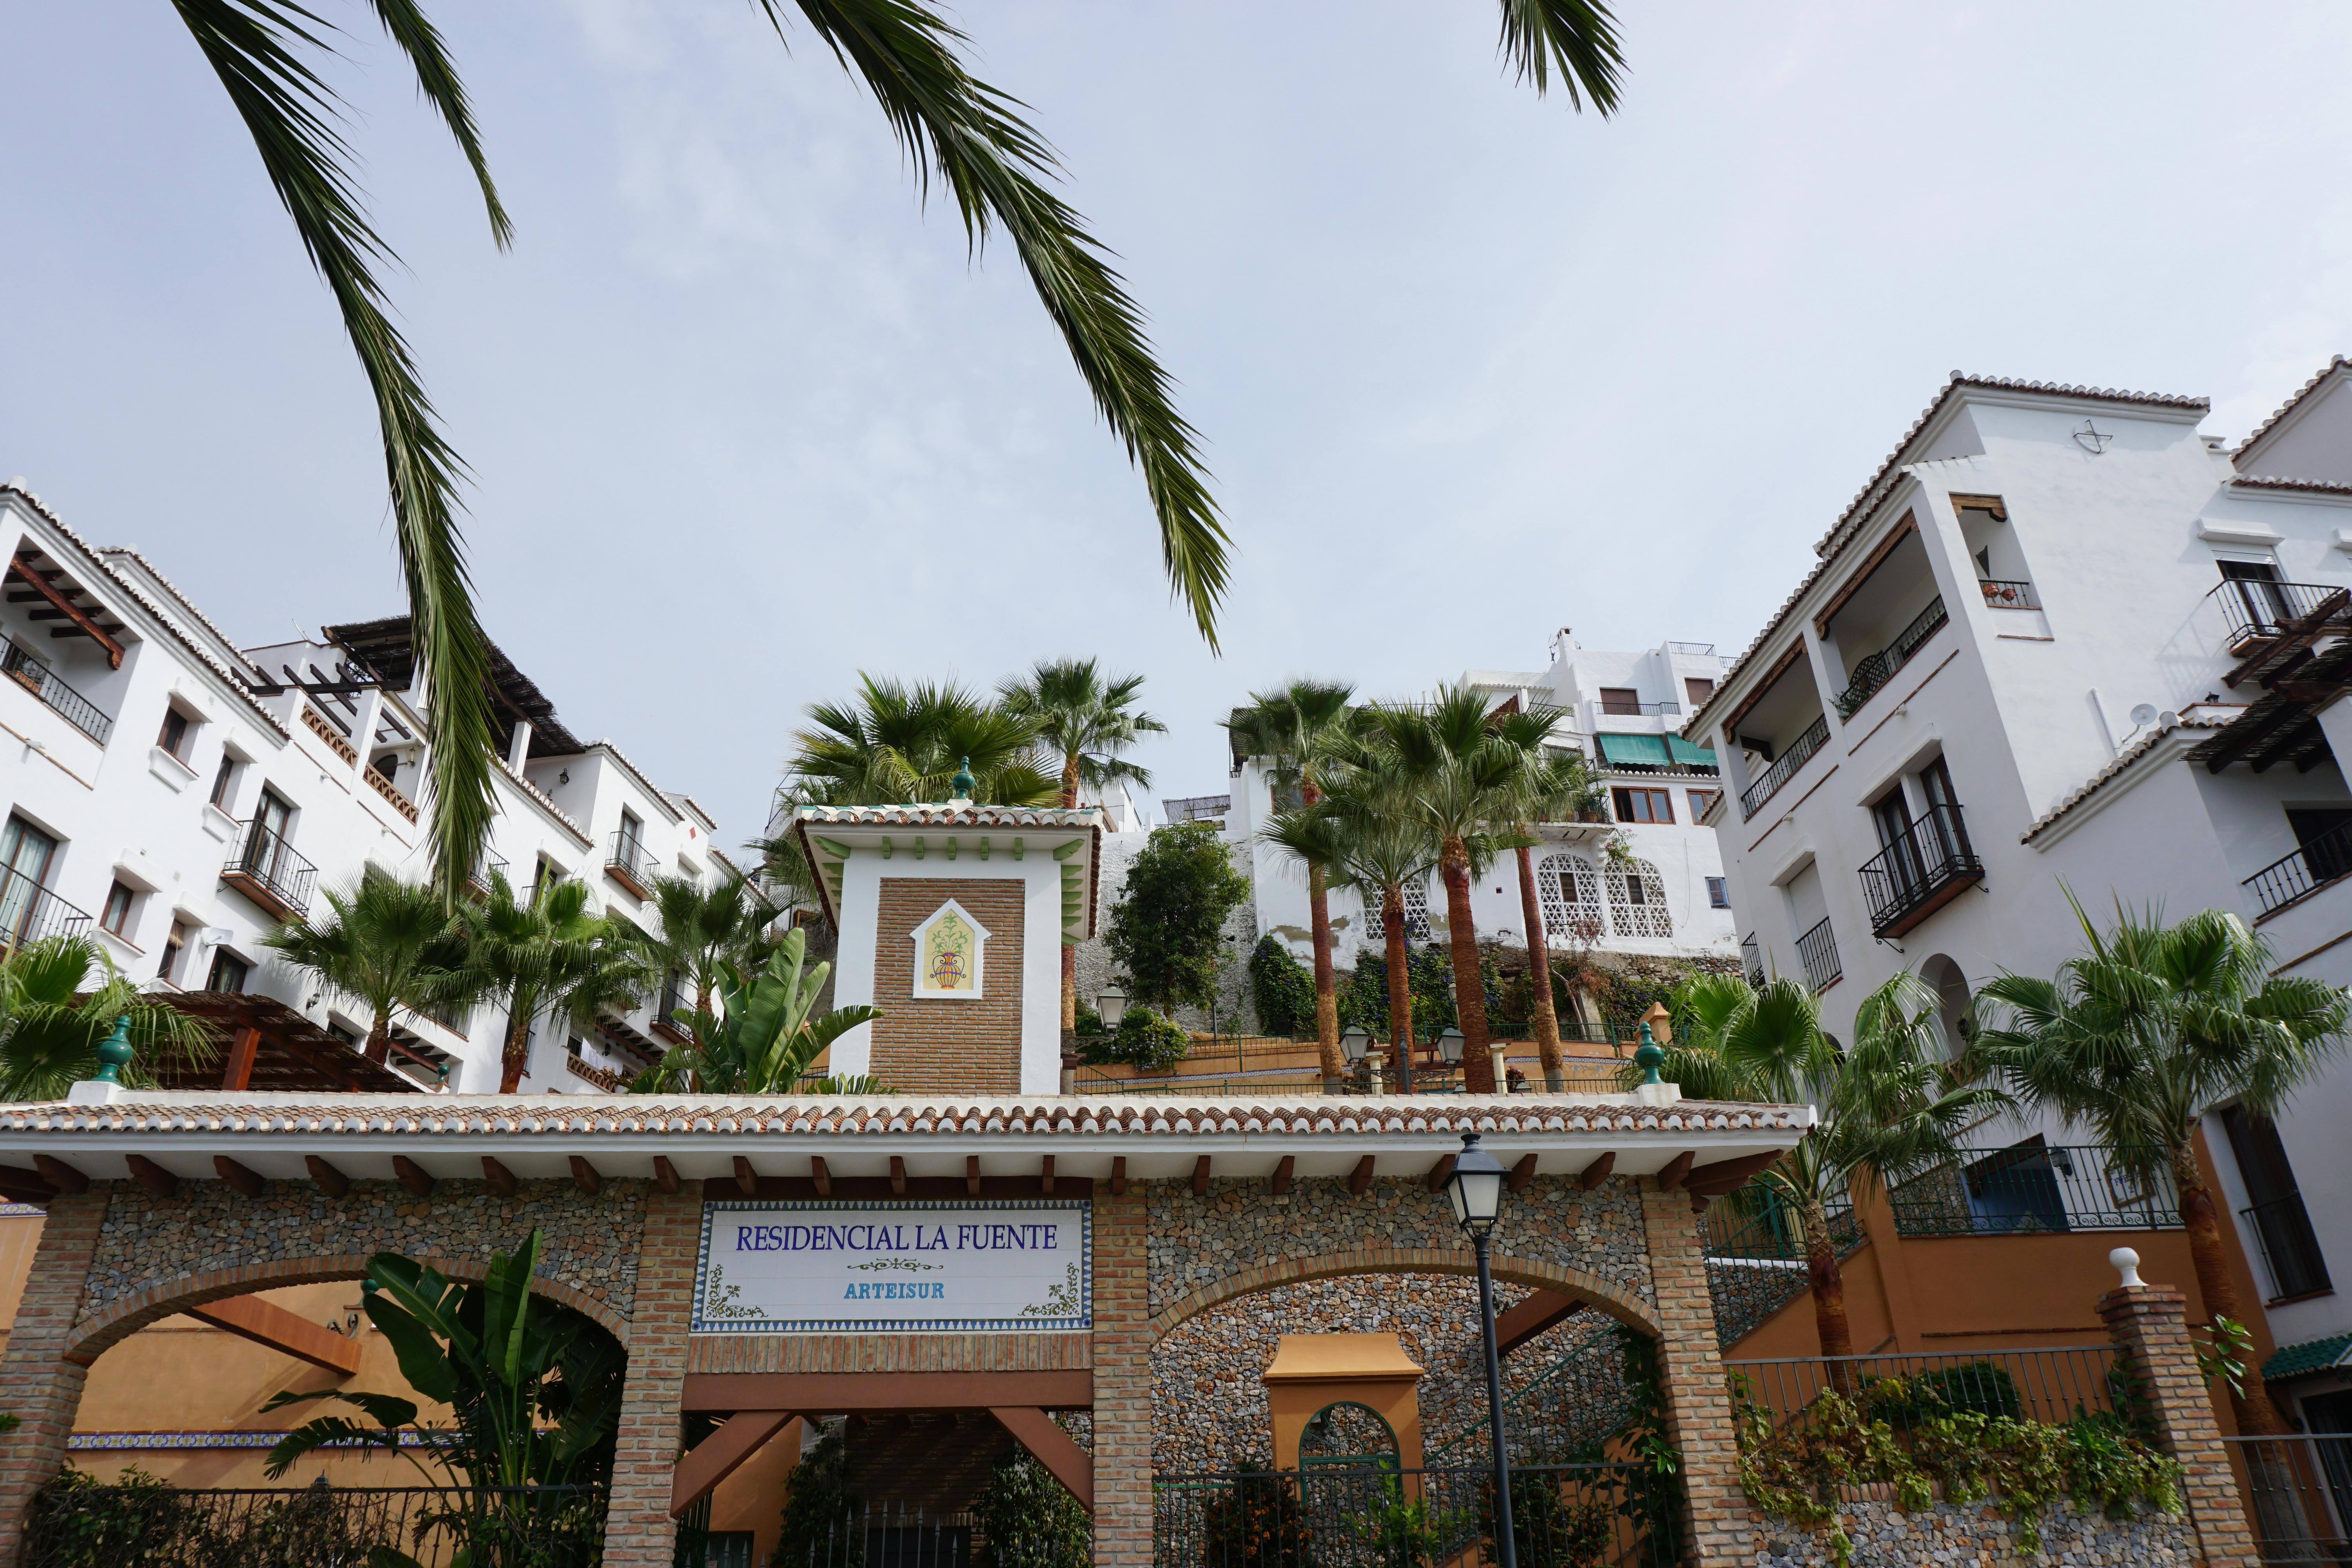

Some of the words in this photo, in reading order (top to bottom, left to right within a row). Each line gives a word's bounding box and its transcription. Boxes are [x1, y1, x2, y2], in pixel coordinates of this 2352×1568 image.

[736, 1225, 909, 1251] RESIDENCIAL
[915, 1225, 949, 1250] LA
[956, 1225, 1057, 1250] FUENTE
[844, 1283, 944, 1299] ARTEISUR
